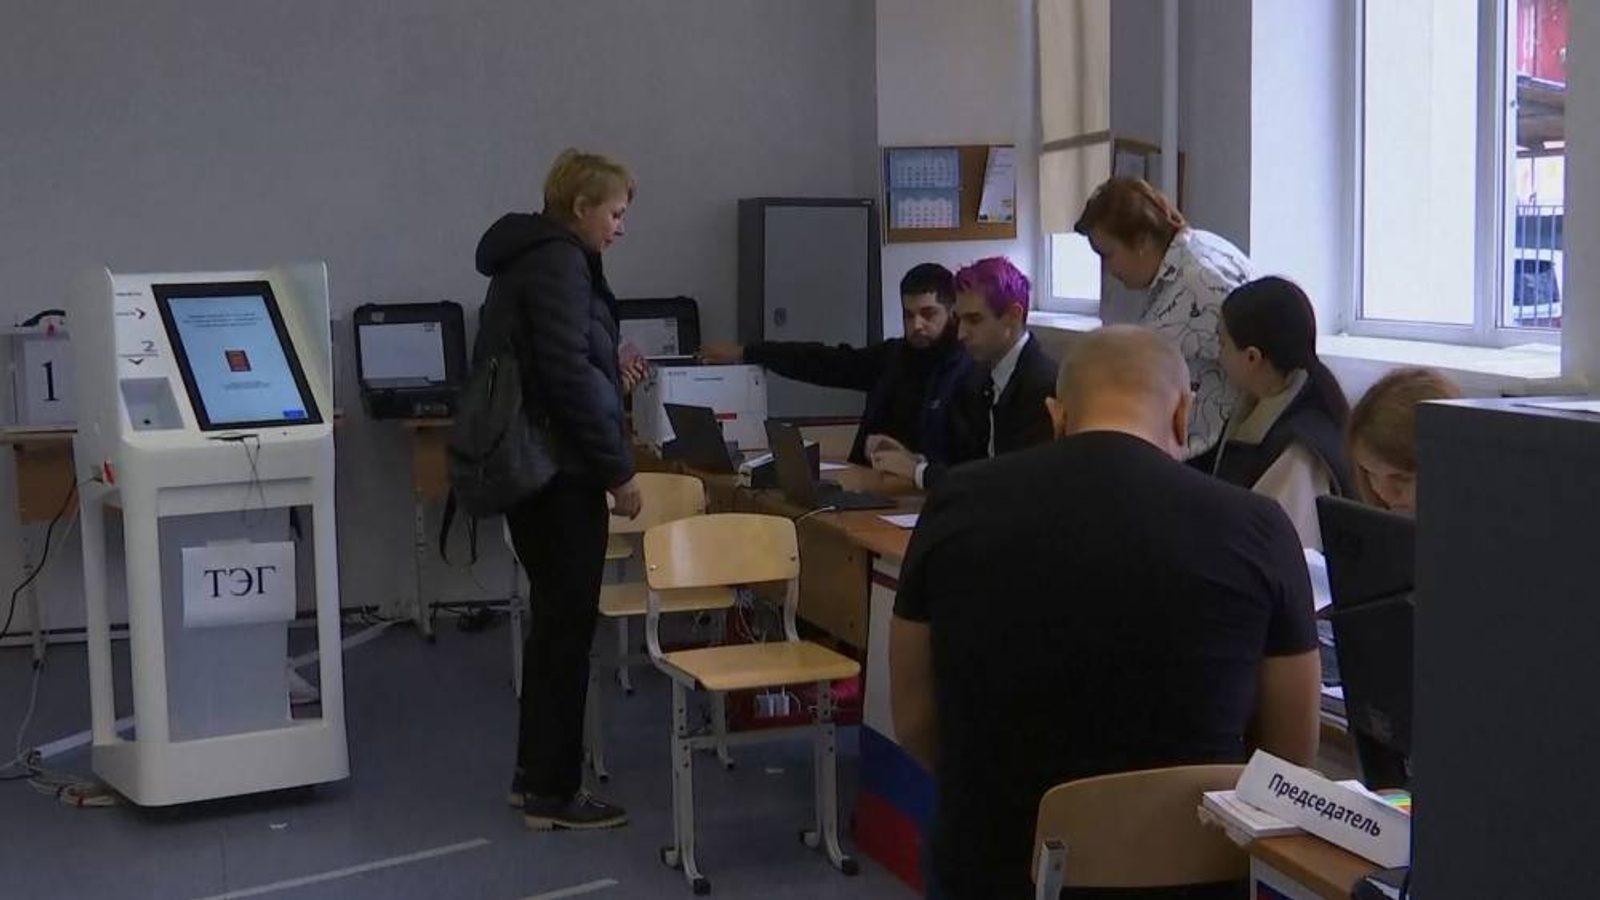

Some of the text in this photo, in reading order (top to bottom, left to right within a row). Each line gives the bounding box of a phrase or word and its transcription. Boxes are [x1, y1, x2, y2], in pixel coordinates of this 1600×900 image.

[141, 340, 157, 352] 2
[41, 360, 60, 402] 1
[204, 565, 276, 598] ТЭГ
[1268, 773, 1381, 837] Председатель
